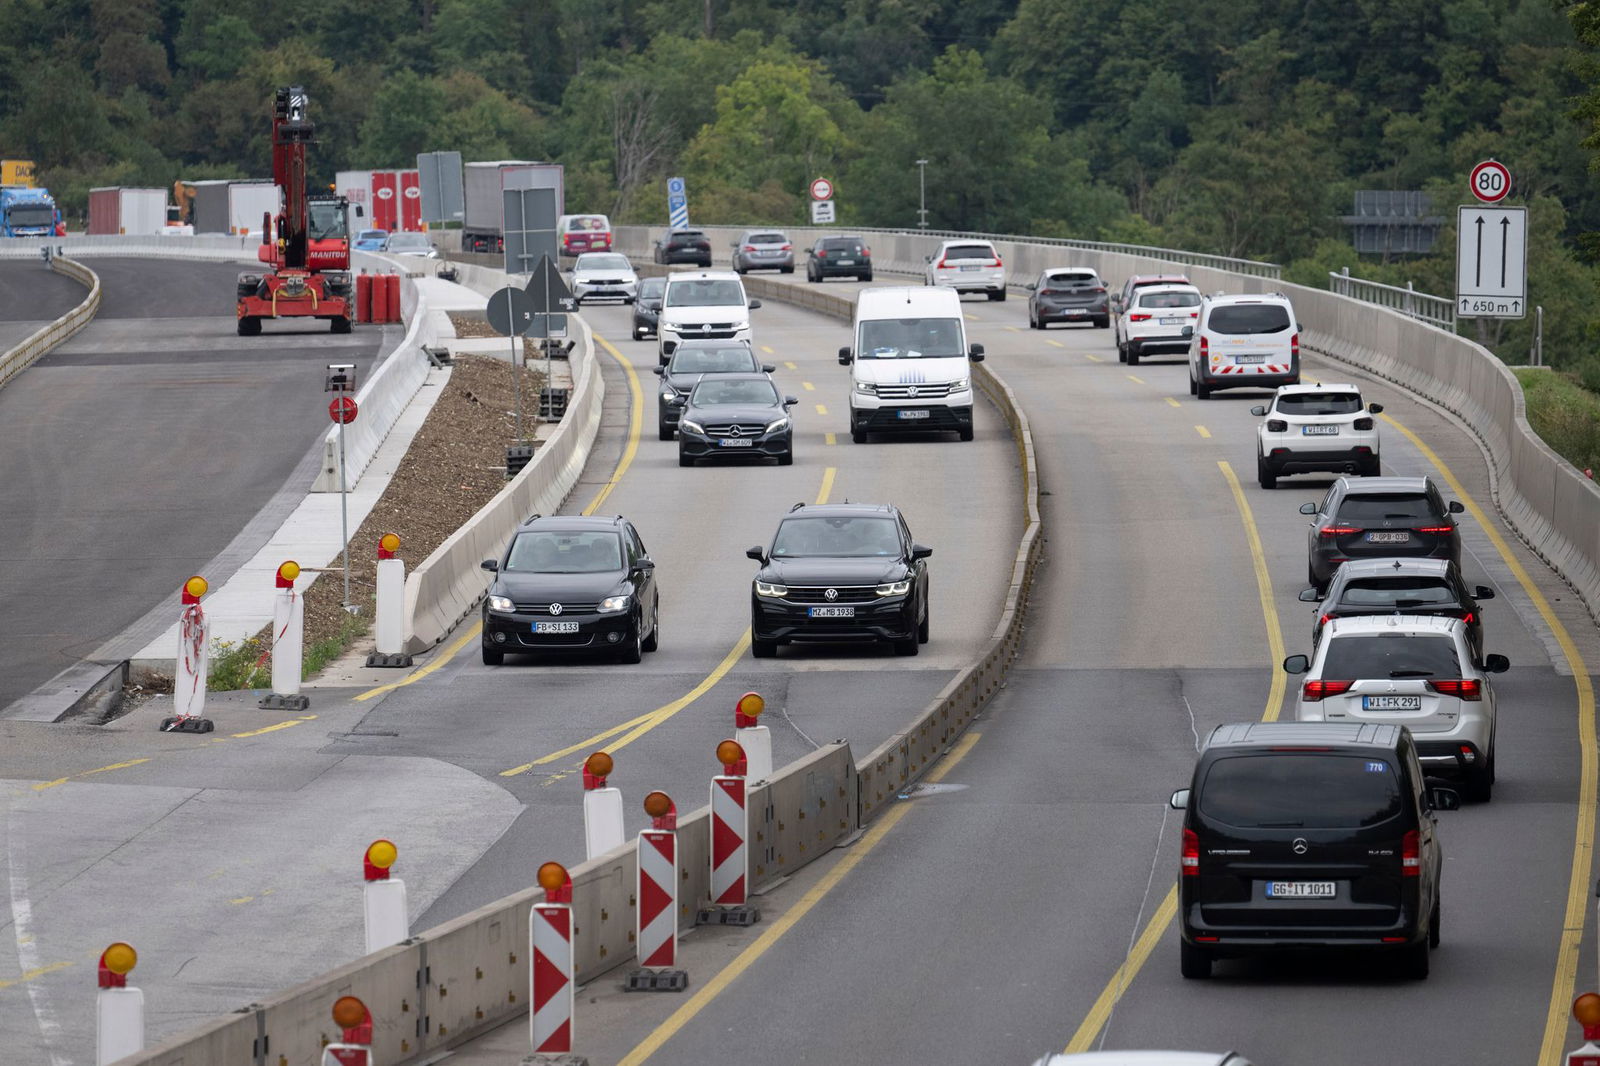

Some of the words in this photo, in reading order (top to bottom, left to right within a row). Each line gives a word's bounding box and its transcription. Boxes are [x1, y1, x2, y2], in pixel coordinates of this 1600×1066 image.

[1479, 172, 1502, 191] 80
[310, 251, 346, 259] MANITOU
[1473, 301, 1495, 312] 650
[1497, 304, 1508, 313] m
[812, 608, 822, 616] MZ
[826, 608, 836, 616] MB
[837, 608, 854, 616] 1938
[536, 623, 547, 631] FB
[552, 623, 561, 631] SI
[563, 623, 578, 631] 133
[1369, 698, 1380, 707] WI
[1387, 698, 1399, 706] FK
[1401, 697, 1419, 707] 291
[1369, 763, 1383, 772] 770
[1273, 884, 1287, 895] GG
[1294, 884, 1306, 895] IT
[1308, 884, 1332, 895] 1011
